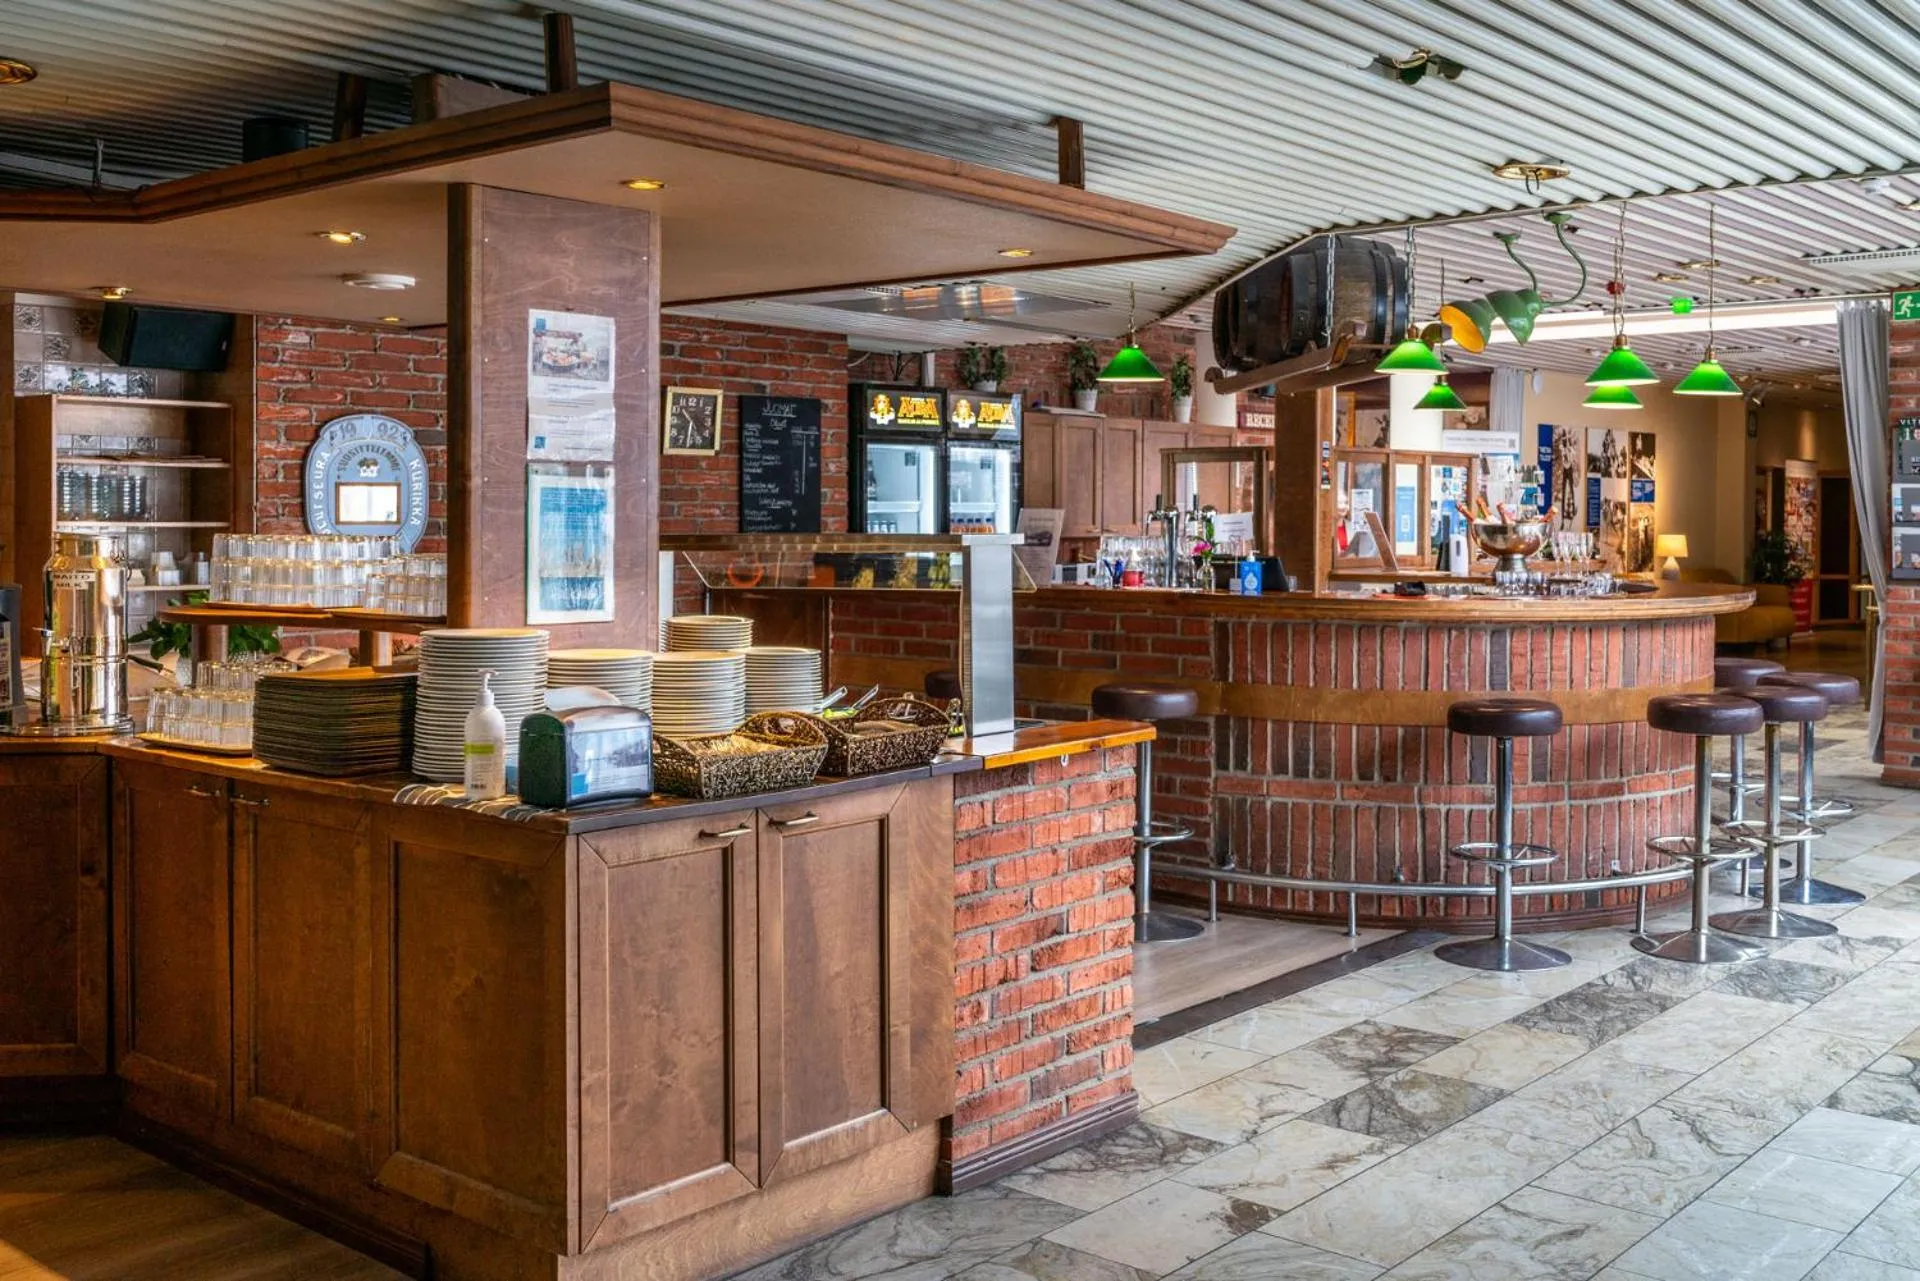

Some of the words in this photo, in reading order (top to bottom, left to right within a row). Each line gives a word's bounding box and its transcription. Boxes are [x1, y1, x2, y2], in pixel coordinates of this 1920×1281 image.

[687, 397, 697, 407] 12
[704, 406, 713, 415] 2
[1246, 412, 1275, 428] RECE
[339, 422, 357, 439] 19
[377, 422, 399, 439] 92
[702, 429, 710, 437] 4
[410, 459, 424, 525] KURIKKA
